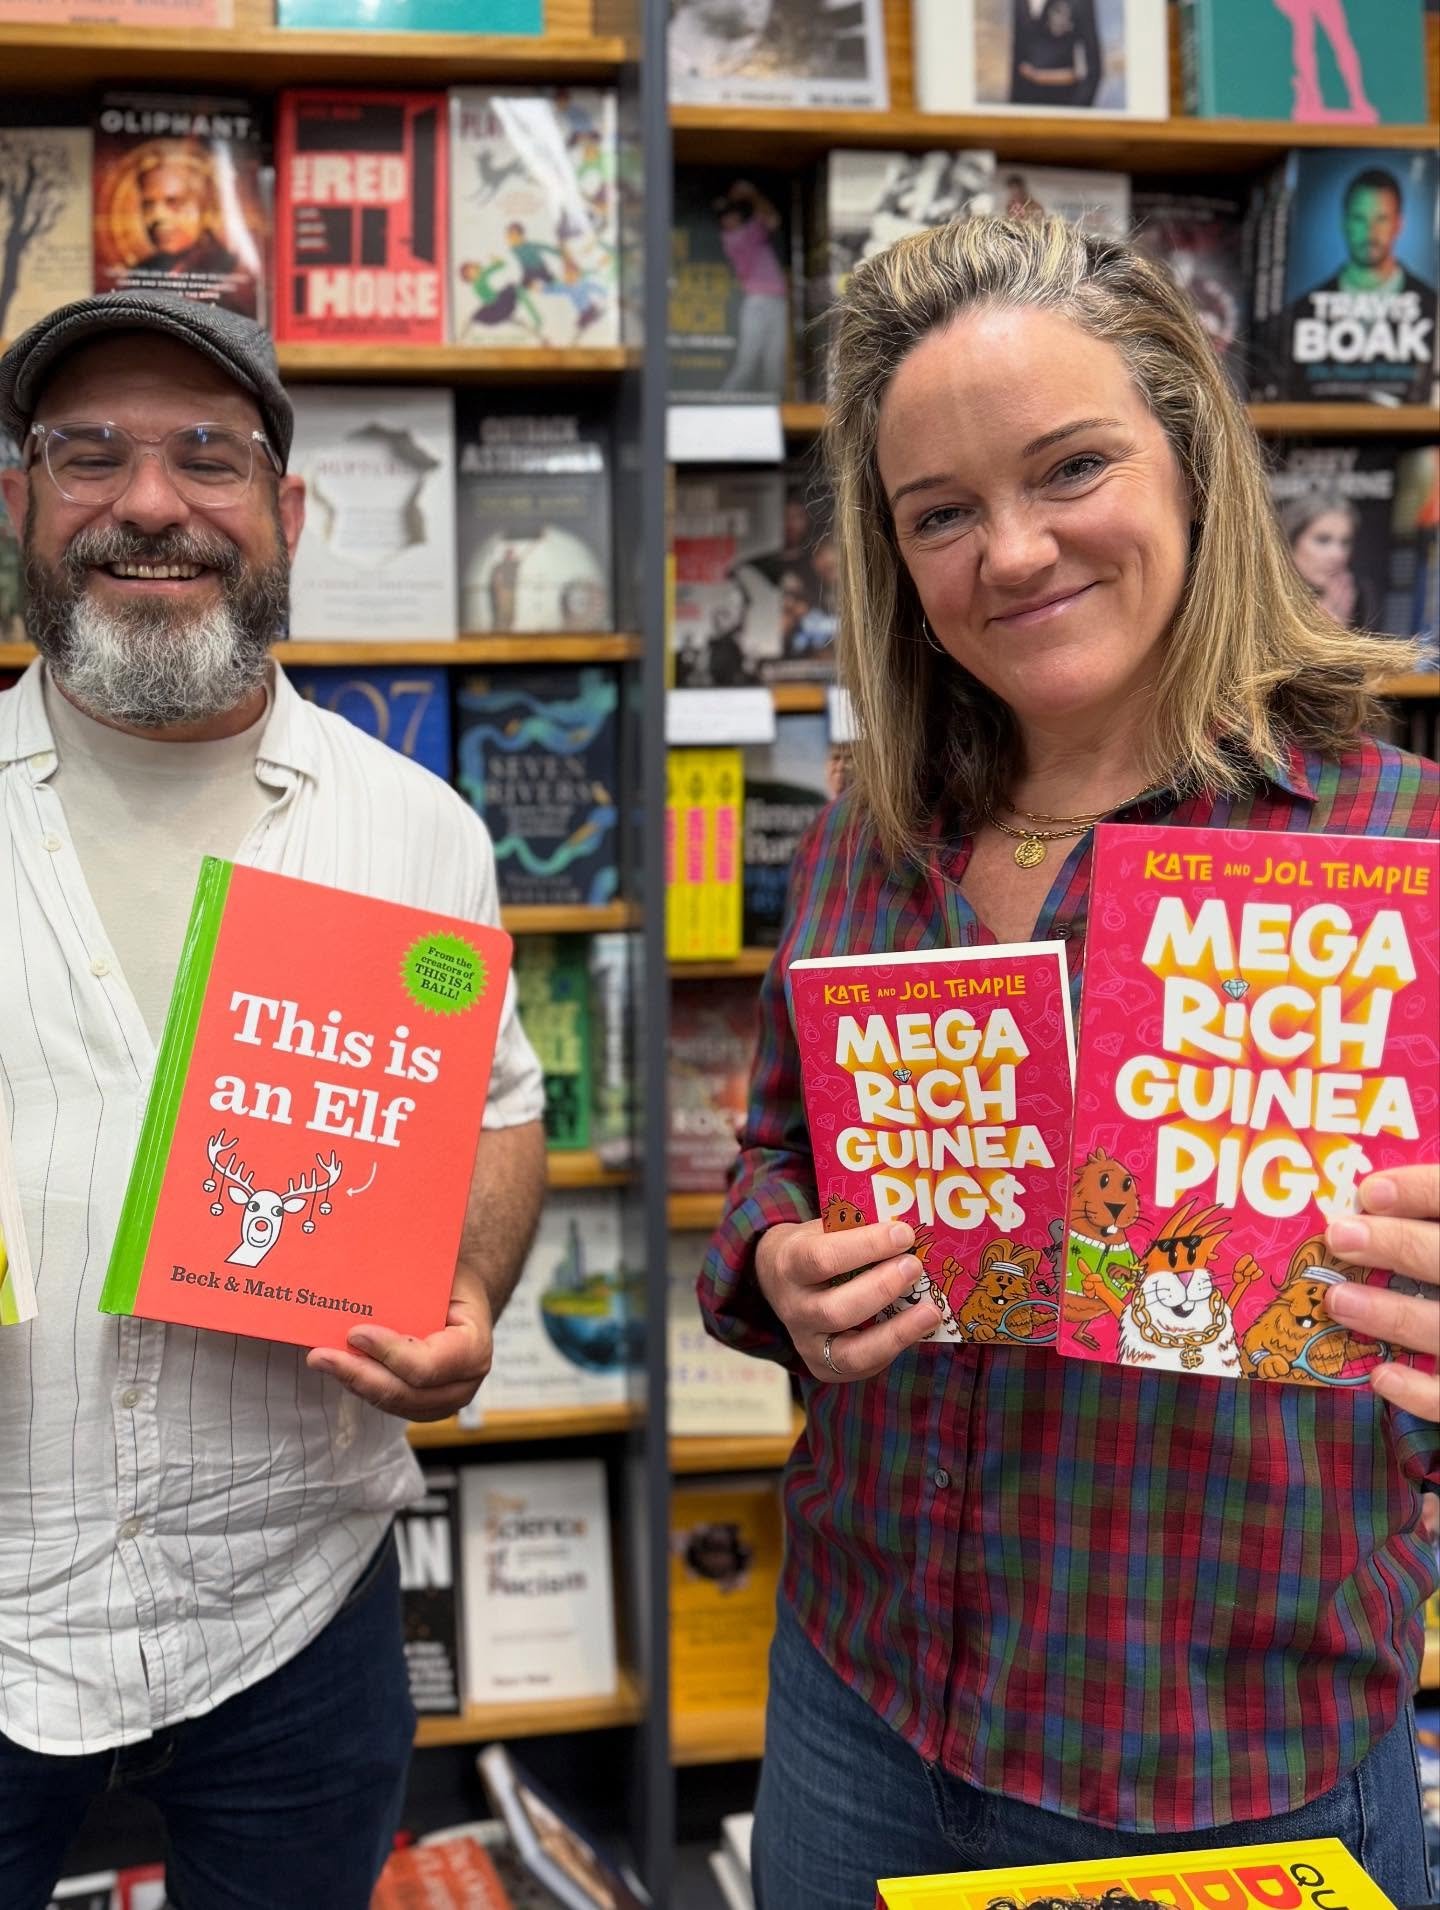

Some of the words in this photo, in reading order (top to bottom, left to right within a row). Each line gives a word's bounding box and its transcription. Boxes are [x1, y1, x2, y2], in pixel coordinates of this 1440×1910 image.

[1309, 291, 1421, 321] TRAVIS
[1292, 317, 1432, 363] BOAK
[1145, 850, 1212, 881] KATE
[1224, 863, 1250, 877] AND
[1254, 857, 1313, 886] JOL
[1321, 862, 1430, 895] TEMPLE
[428, 947, 454, 963] From
[456, 958, 472, 969] the
[1142, 897, 1417, 981] MEGA
[416, 963, 448, 983] THIS
[448, 976, 462, 988] IS
[463, 982, 472, 992] A
[421, 956, 462, 976] creators
[463, 971, 475, 979] of
[421, 979, 460, 1000] BALL!
[824, 985, 870, 1005] KATE
[878, 988, 896, 998] AND
[900, 981, 940, 1000] JOL
[944, 975, 1026, 999] TEMPLE
[230, 991, 374, 1069] This
[384, 1026, 441, 1083] is
[835, 1008, 1030, 1066] MEGA
[209, 1074, 292, 1126] an
[306, 1081, 416, 1148] Elf
[1115, 1055, 1420, 1140] GUINEA
[836, 1125, 1055, 1171] GUINEA
[170, 1264, 221, 1291] Beck
[224, 1276, 240, 1292] &
[243, 1279, 292, 1303] Matt
[295, 1287, 374, 1318] Stanton
